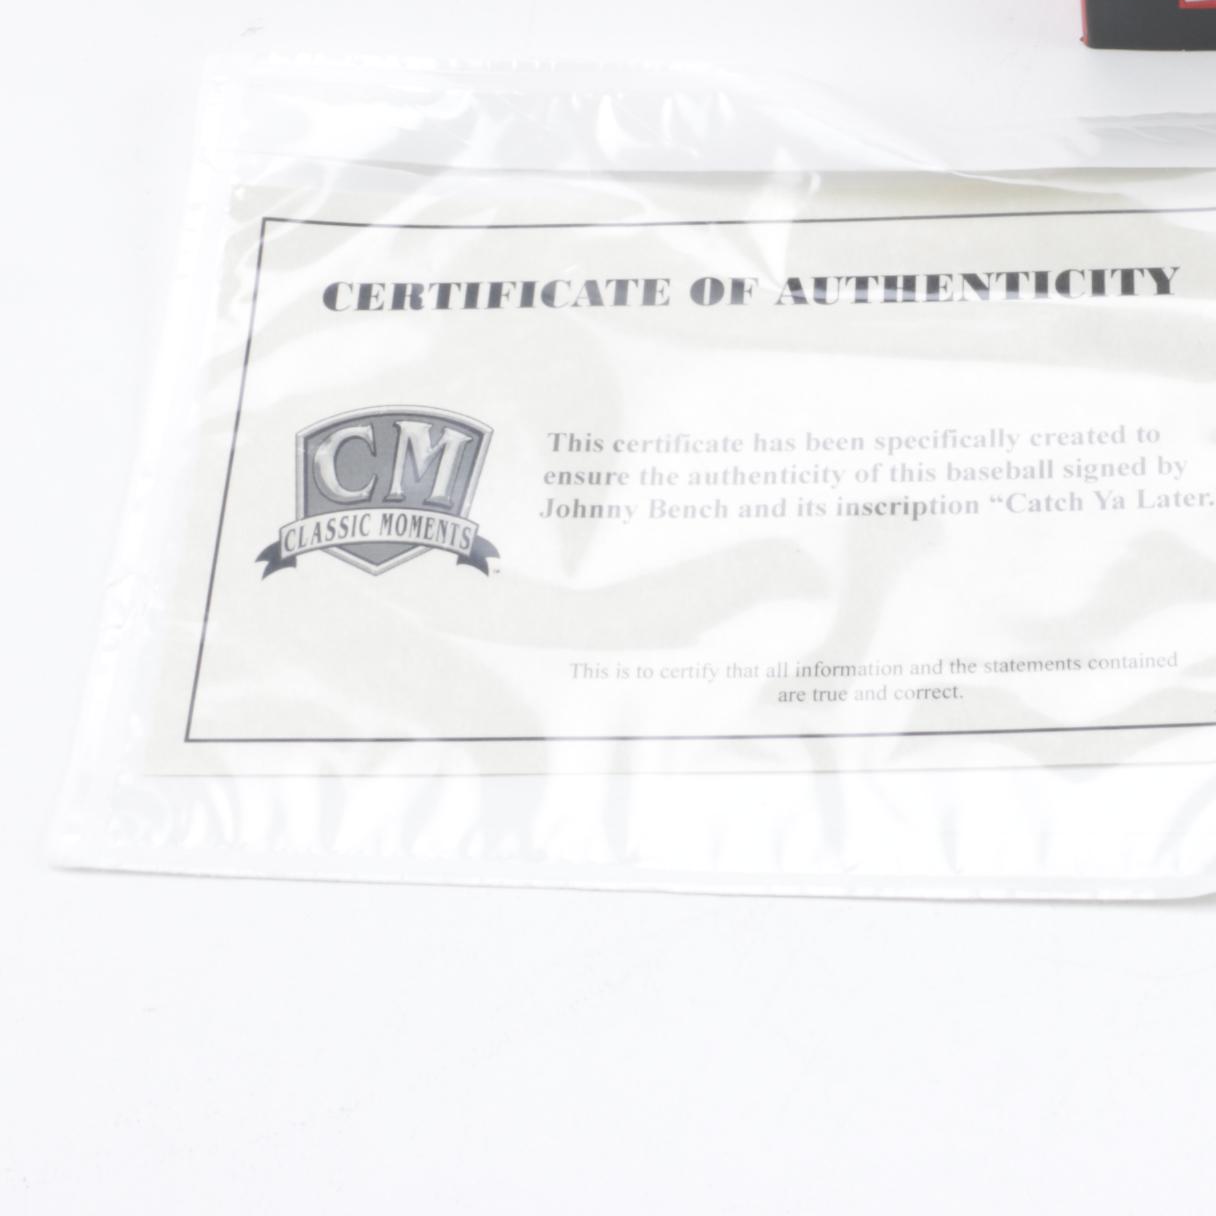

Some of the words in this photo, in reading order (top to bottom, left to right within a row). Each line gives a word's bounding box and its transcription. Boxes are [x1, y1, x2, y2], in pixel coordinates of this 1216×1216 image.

[322, 277, 671, 312] CERTIFICATE
[689, 276, 759, 306] OF
[775, 266, 1180, 306] AUTHENTICITY
[547, 432, 604, 453] This
[612, 432, 744, 453] certificate
[752, 432, 797, 453] has
[805, 431, 865, 452] been
[874, 427, 1020, 456] specifically
[1029, 424, 1127, 447] created
[1136, 425, 1161, 444] to
[312, 420, 475, 508] CM
[543, 469, 630, 486] ensure
[639, 465, 680, 485] the
[687, 462, 847, 489] authenticity
[854, 461, 880, 484] of
[889, 461, 937, 483] this
[946, 458, 1054, 482] baseball
[1062, 455, 1147, 484] signed
[1156, 455, 1188, 481] by
[539, 497, 639, 525] Johnny
[648, 497, 729, 520] Bench
[738, 496, 787, 519] and
[796, 496, 827, 518] its
[836, 493, 980, 522] inscription
[989, 490, 1084, 514] “Catch
[1093, 489, 1126, 511] Ya
[283, 513, 372, 552] CLASSIC
[379, 513, 472, 551] MOMENTS
[569, 662, 609, 680] This
[615, 662, 630, 680] is
[635, 664, 655, 680] to
[659, 661, 721, 683] certify
[725, 662, 760, 679] that
[765, 661, 789, 679] all
[795, 660, 904, 678] information
[909, 660, 944, 677] and
[949, 658, 978, 674] the
[983, 656, 1083, 673] statements
[1087, 652, 1179, 671] contained
[777, 688, 807, 703] are
[812, 686, 848, 703] true
[853, 684, 888, 702] and
[893, 684, 964, 701] correct.
